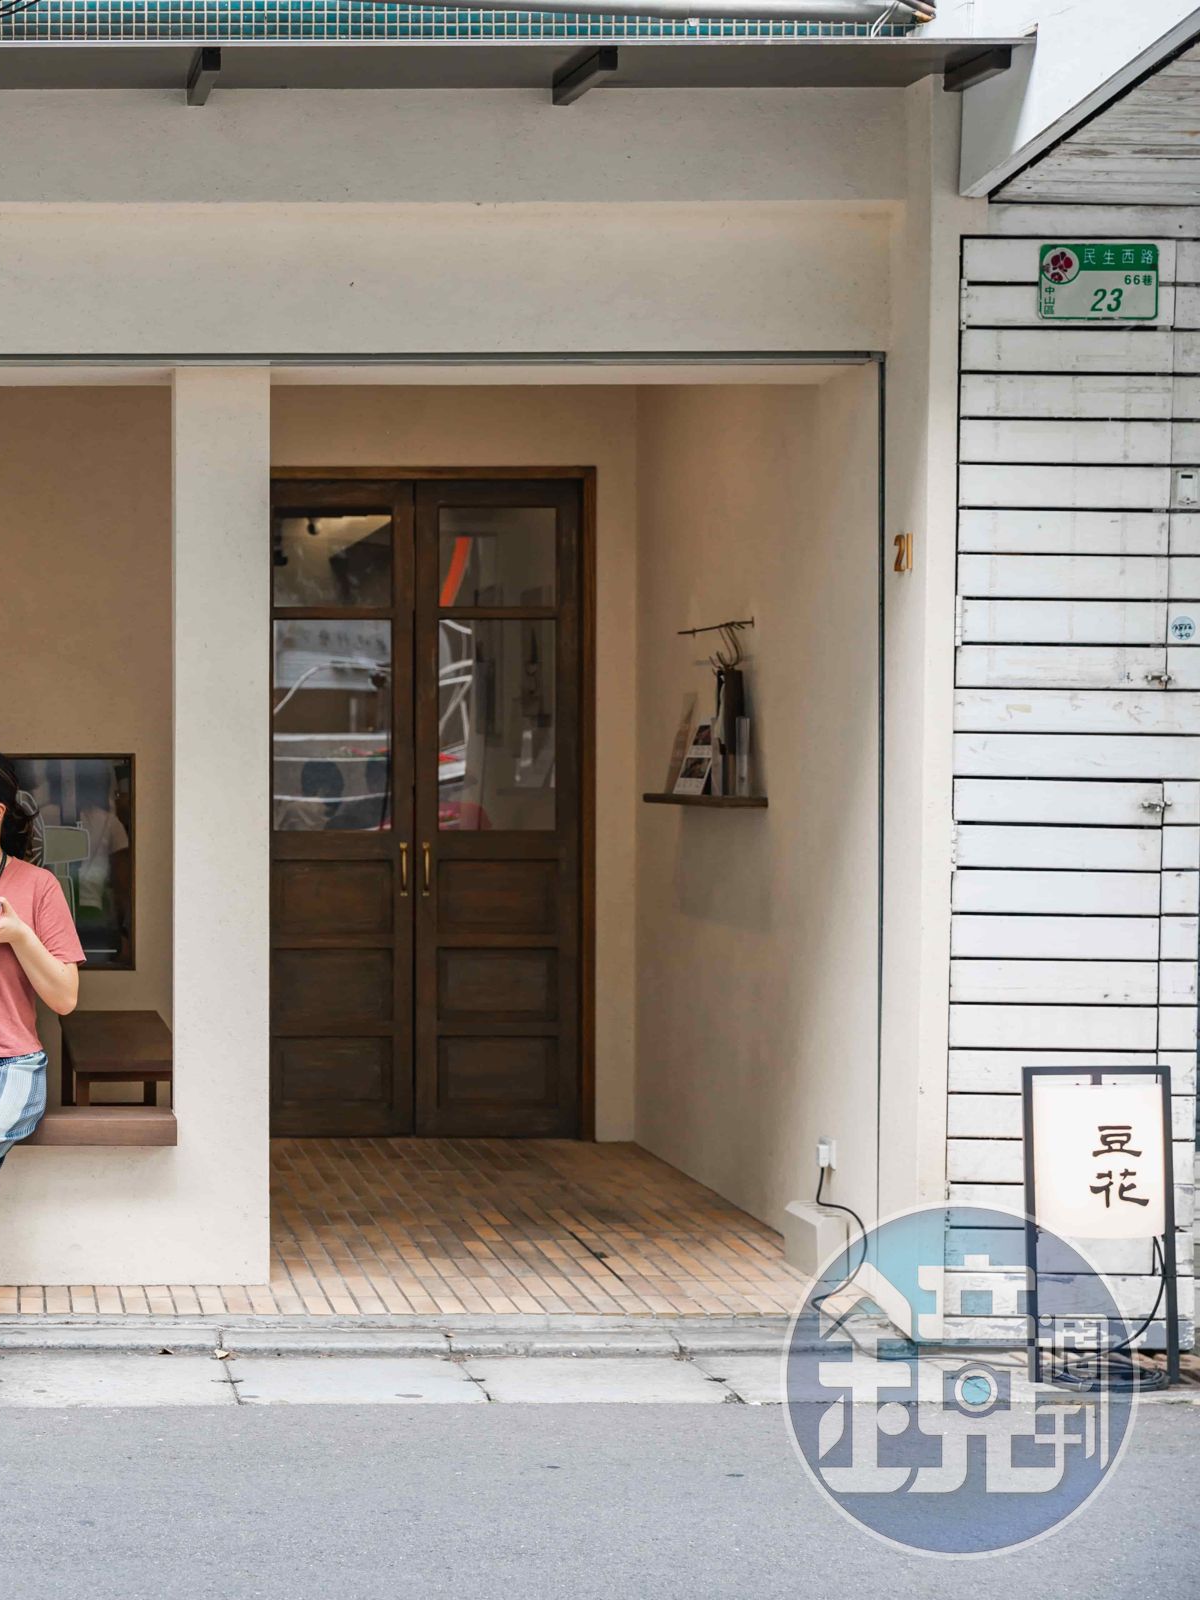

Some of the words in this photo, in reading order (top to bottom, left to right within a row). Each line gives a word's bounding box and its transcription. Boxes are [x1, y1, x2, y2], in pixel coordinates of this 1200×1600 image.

[1083, 248, 1153, 265] 民生西路
[1124, 275, 1153, 286] 66巷
[1044, 286, 1055, 315] 中山區
[1090, 288, 1123, 312] 23
[893, 532, 913, 572] 21
[1089, 1125, 1149, 1208] 豆花
